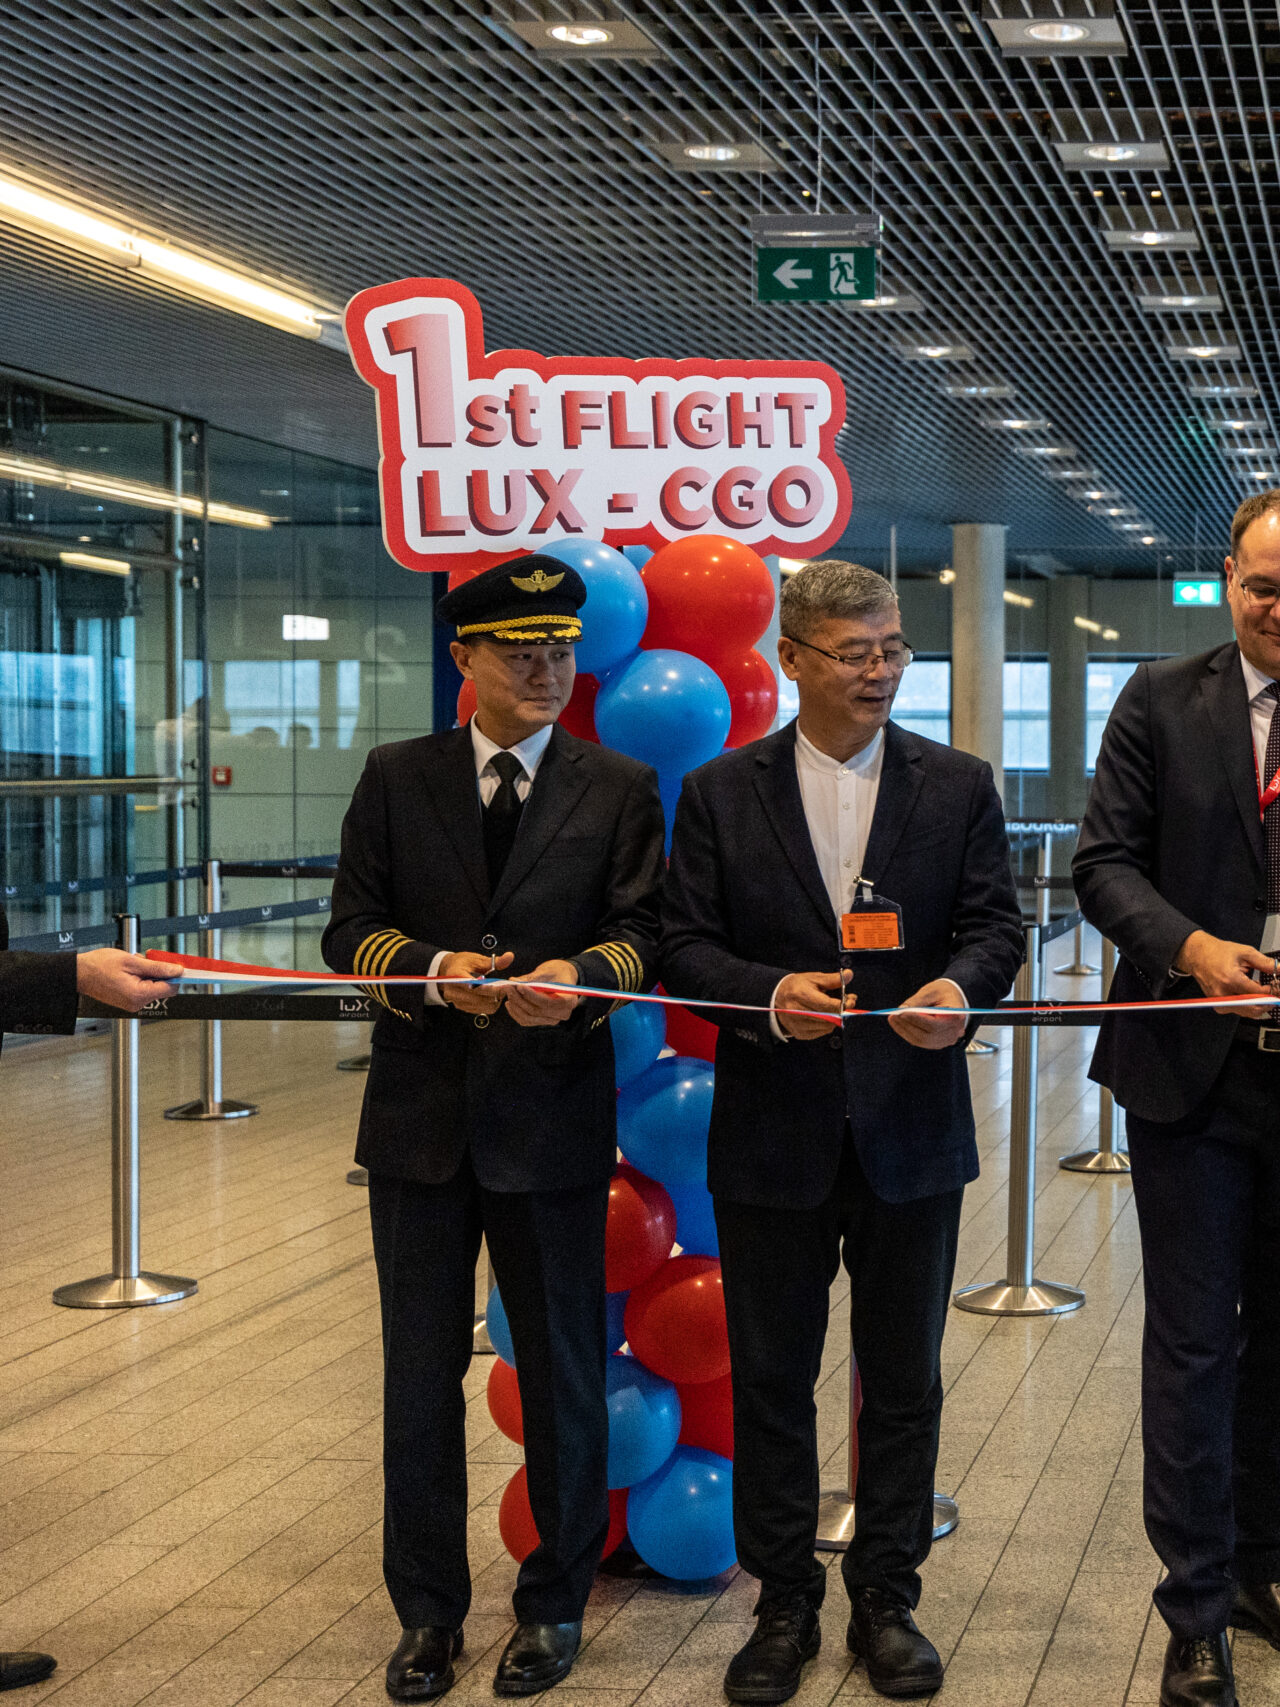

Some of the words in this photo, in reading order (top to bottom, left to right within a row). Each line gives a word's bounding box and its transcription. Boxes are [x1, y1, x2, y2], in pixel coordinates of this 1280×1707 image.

[382, 313, 542, 448] 1st
[561, 390, 818, 449] FLIGHT
[418, 468, 588, 537] LUX
[608, 493, 638, 513] -
[660, 465, 824, 530] CGO
